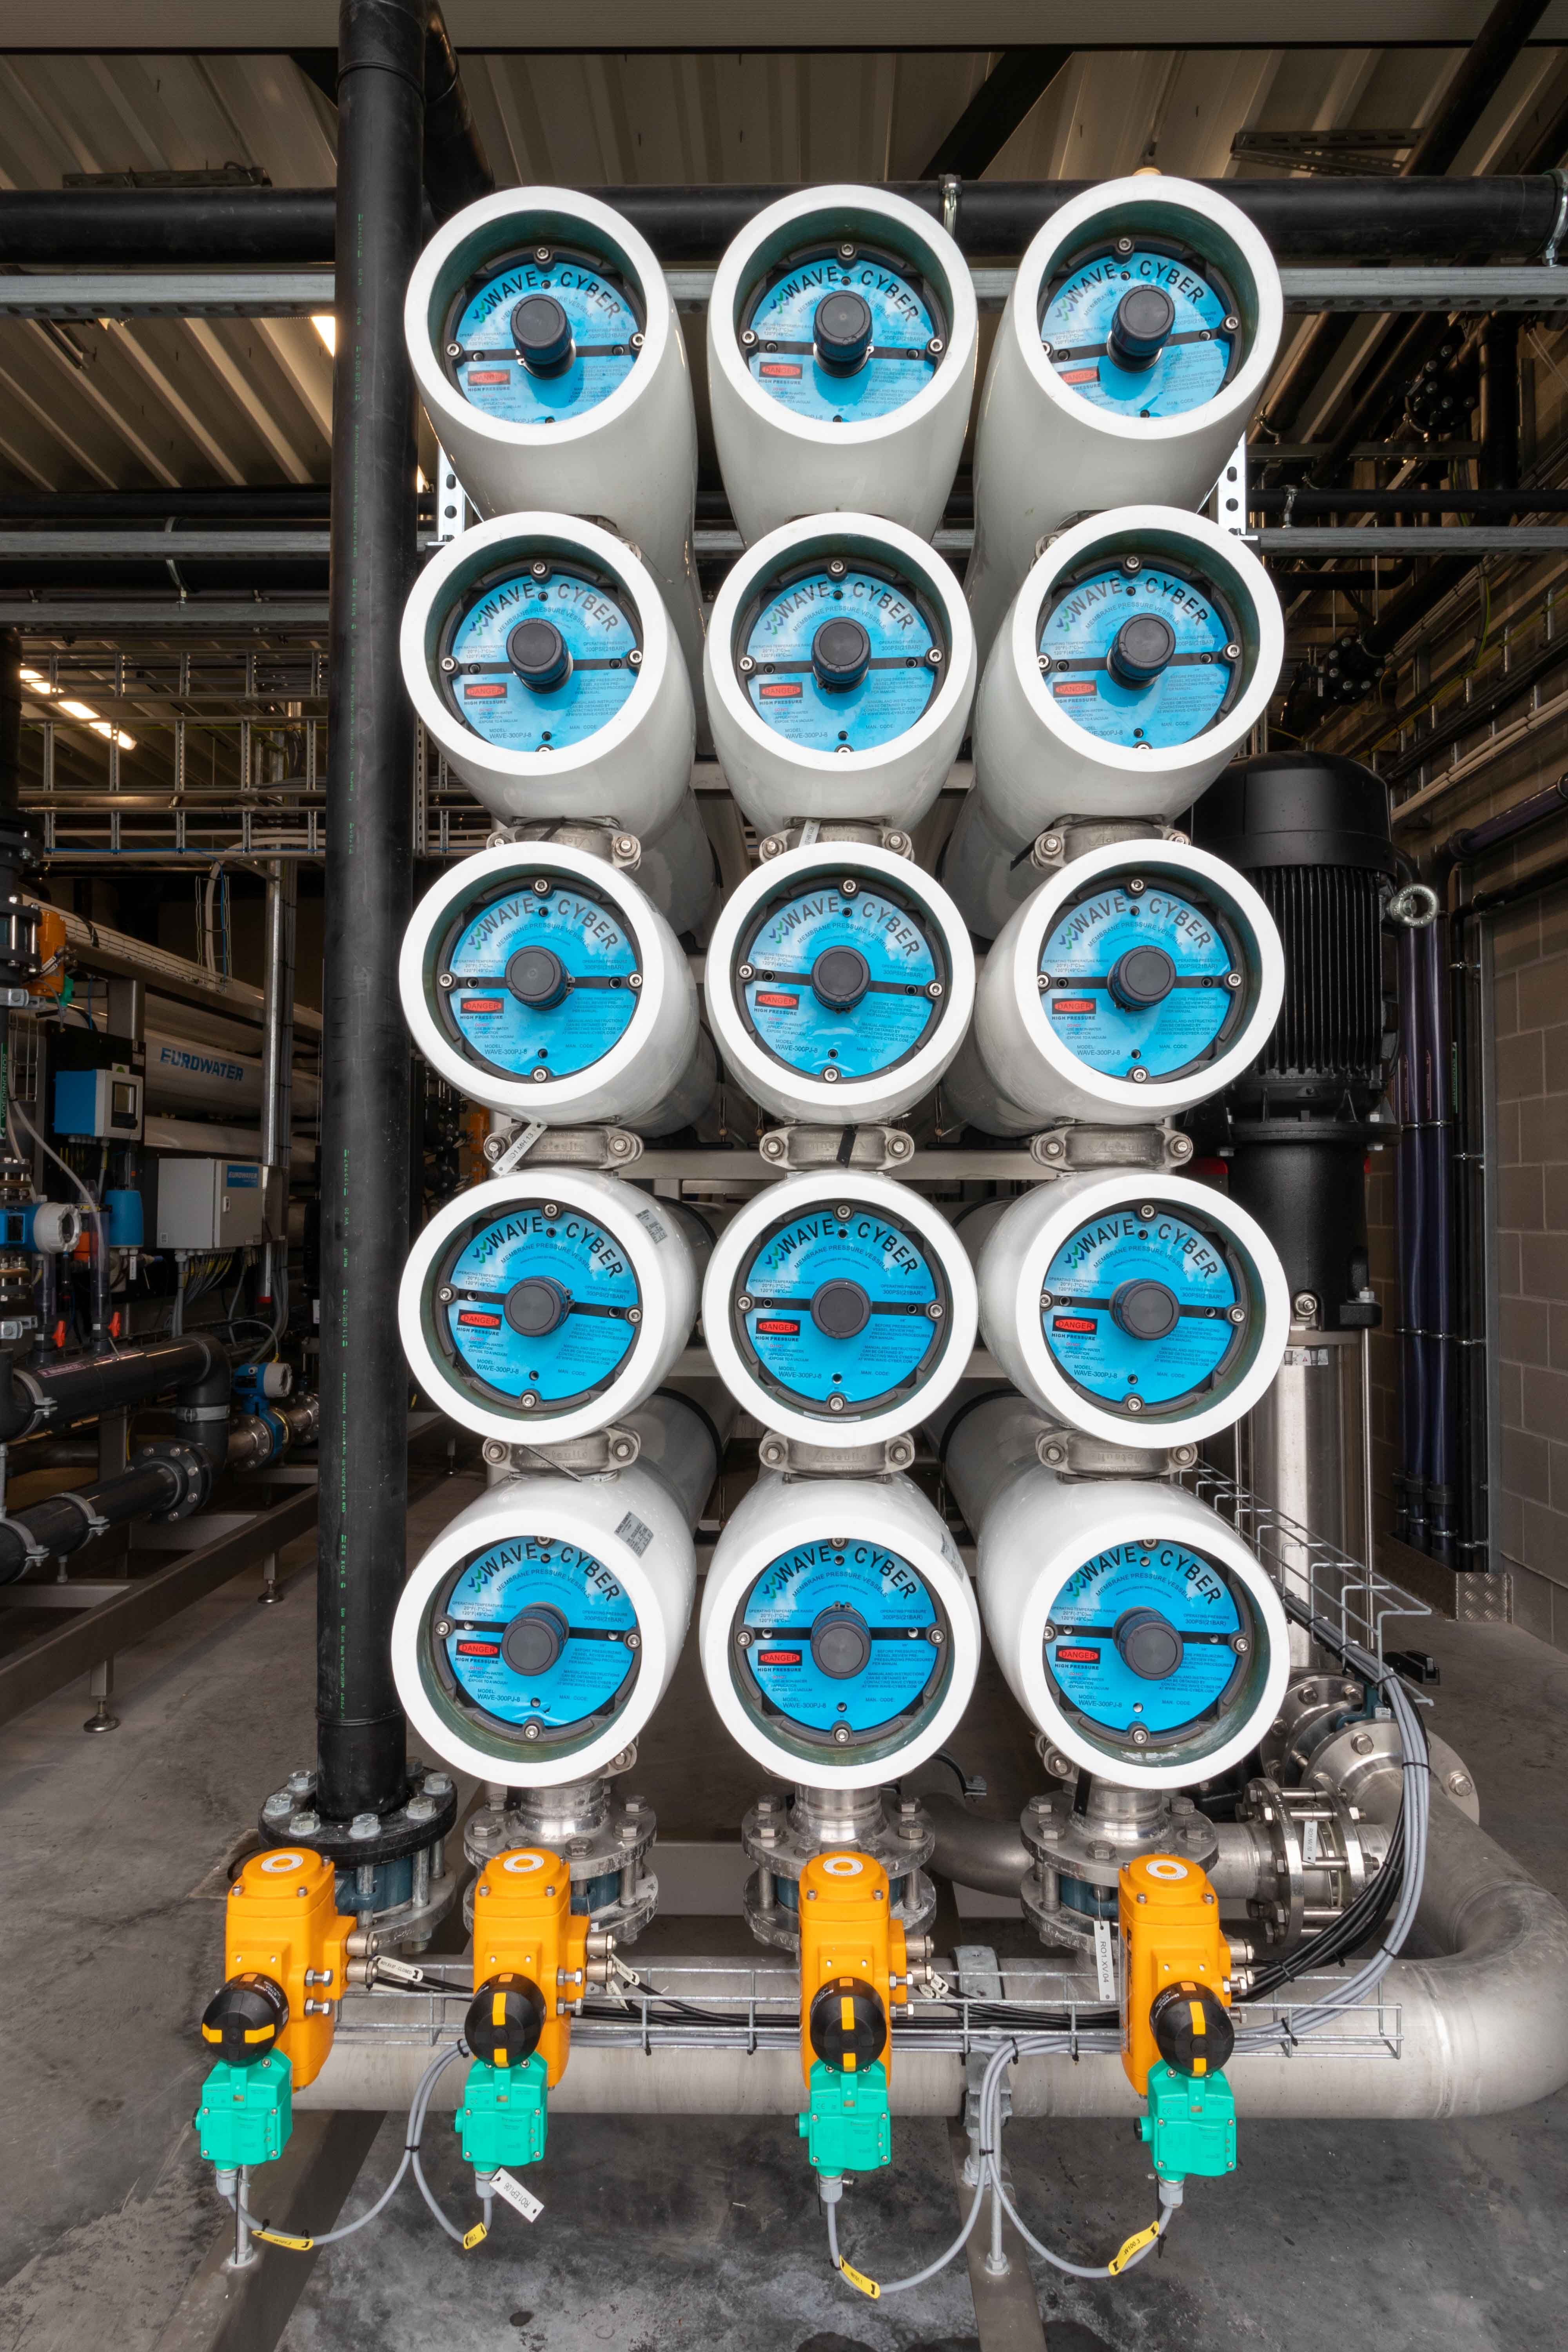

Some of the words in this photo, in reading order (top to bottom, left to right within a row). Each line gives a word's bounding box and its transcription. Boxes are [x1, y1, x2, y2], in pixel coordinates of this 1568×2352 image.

[483, 271, 538, 308] WAVE
[561, 271, 621, 319] CYBER
[781, 266, 838, 300] WAVE
[861, 270, 918, 322] CYBER
[1063, 263, 1118, 305] WAVE
[1140, 260, 1204, 304] CYBER
[479, 583, 535, 620] WAVE
[558, 583, 618, 632] CYBER
[775, 581, 830, 619] WAVE
[853, 581, 913, 630] CYBER
[1067, 577, 1123, 616] WAVE
[1146, 577, 1208, 626] CYBER
[1085, 605, 1117, 630] MEMBRANE
[1155, 606, 1180, 625] VESSELS
[498, 610, 529, 633] MEMBRANE
[566, 612, 590, 631] VESSELS
[793, 609, 824, 633] MEMBRANE
[862, 610, 886, 629] VESSELS
[479, 898, 535, 935] WAVE
[559, 900, 618, 950] CYBER
[497, 926, 529, 948] MEMBRANE
[566, 928, 590, 948] VESSELS
[781, 897, 839, 929] WAVE
[863, 902, 920, 957] CYBER
[797, 924, 831, 944] MEMBRANE
[832, 923, 867, 933] PRESSURE
[868, 931, 891, 953] VESSELS
[1070, 897, 1127, 934] WAVE
[1151, 898, 1211, 949] CYBER
[1088, 925, 1120, 948] MEMBRANE
[1158, 927, 1183, 947] VESSELS
[761, 996, 795, 1005] DANGER
[160, 1047, 244, 1081] EUROWATER
[486, 1217, 543, 1249] WAVE
[567, 1223, 622, 1278] CYBER
[501, 1245, 535, 1264] MEMBRANE
[536, 1243, 570, 1254] PRESSURE
[572, 1252, 594, 1274] VESSELS
[777, 1219, 835, 1255] WAVE
[858, 1222, 918, 1276] CYBER
[794, 1247, 828, 1269] MEMBRANE
[828, 1245, 864, 1254] PRESSURE
[865, 1252, 889, 1273] VESSELS
[1077, 1220, 1135, 1254] WAVE
[1159, 1224, 1217, 1279] CYBER
[1093, 1247, 1127, 1269] MEMBRANE
[1129, 1246, 1163, 1256] PRESSURE
[1165, 1254, 1189, 1275] VESSELS
[464, 1316, 497, 1325] DANGER
[1059, 1322, 1093, 1331] DANGER
[480, 1543, 538, 1577] WAVE
[561, 1547, 619, 1602] CYBER
[496, 1571, 530, 1592] MEMBRANE
[531, 1569, 566, 1579] PRESSURE
[568, 1577, 591, 1598] VESSELS
[774, 1545, 831, 1583] WAVE
[855, 1547, 916, 1599] CYBER
[792, 1574, 825, 1598] MEMBRANE
[826, 1572, 861, 1580] PRESSURE
[863, 1577, 888, 1598] VESSELS
[1079, 1546, 1137, 1582] WAVE
[1161, 1550, 1220, 1604] CYBER
[1096, 1575, 1130, 1597] MEMBRANE
[1131, 1573, 1166, 1583] PRESSURE
[1168, 1580, 1192, 1602] VESSELS
[462, 1646, 495, 1654] DANGER
[1100, 1941, 1109, 1983] RO1.XV.04
